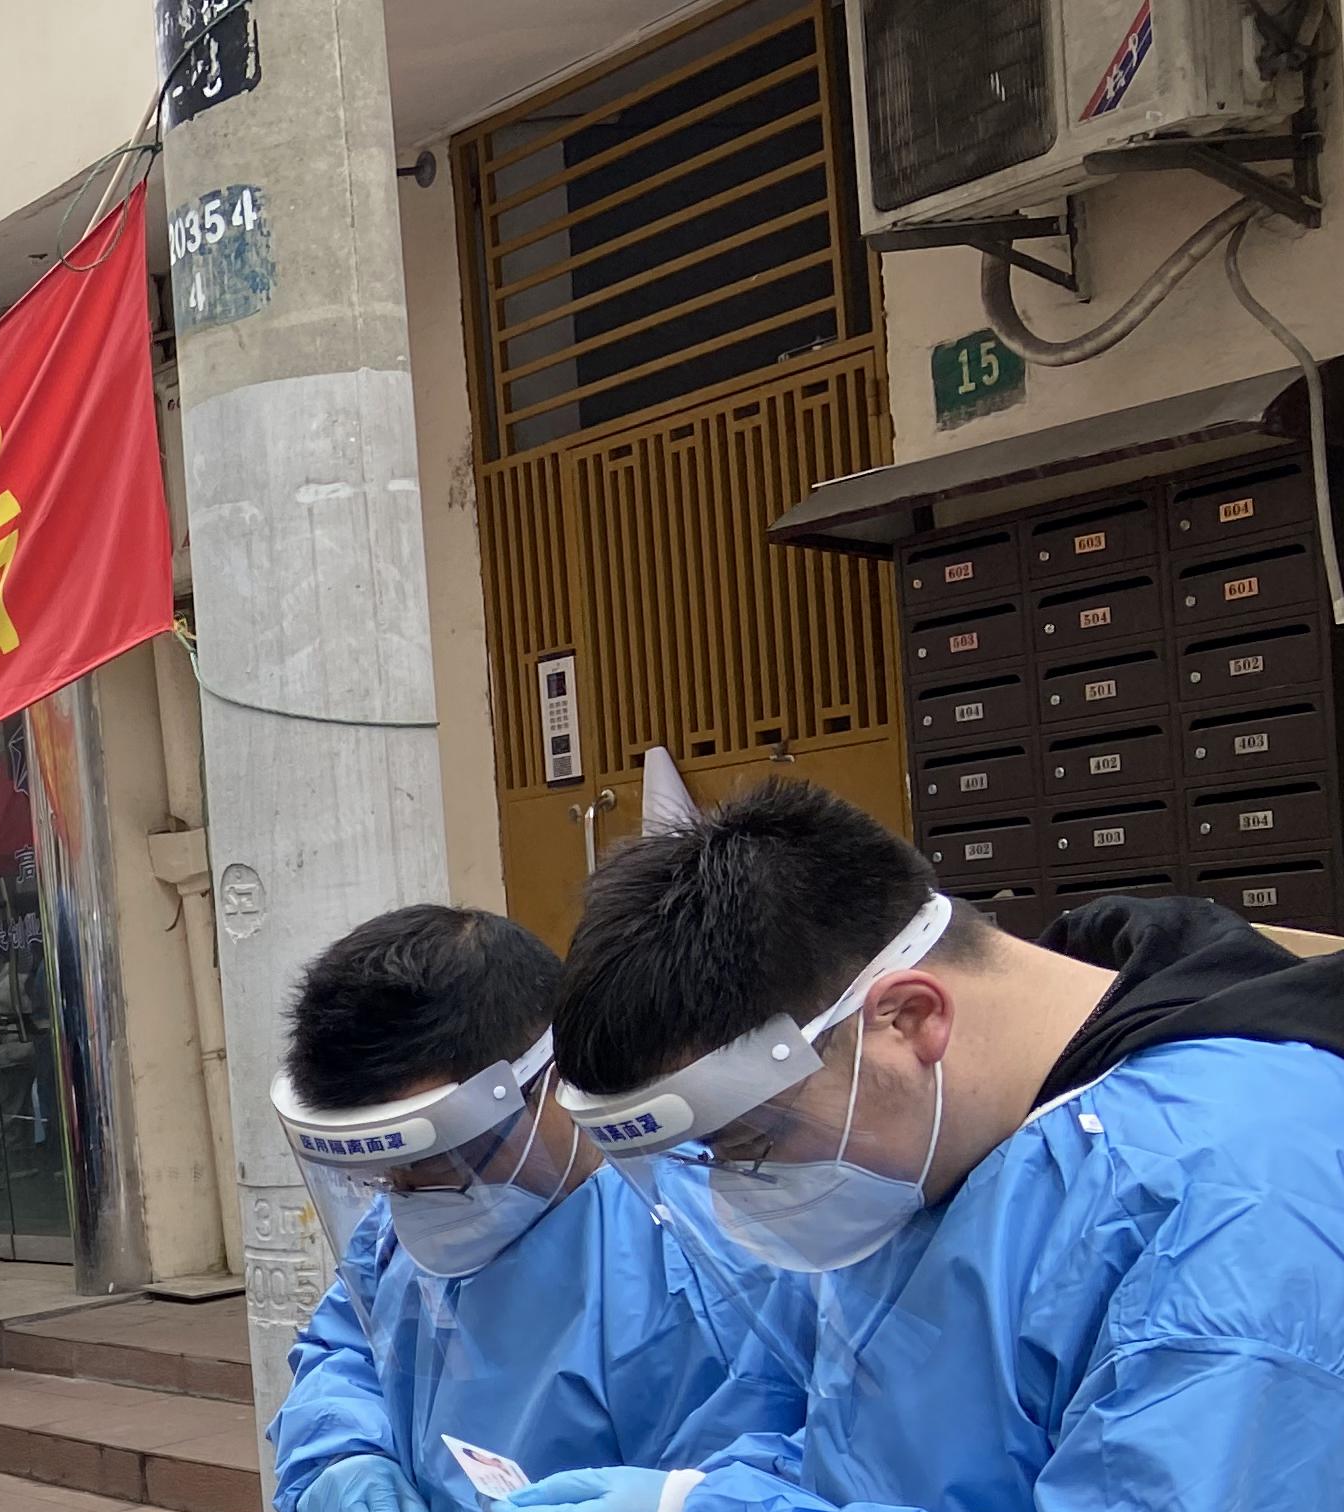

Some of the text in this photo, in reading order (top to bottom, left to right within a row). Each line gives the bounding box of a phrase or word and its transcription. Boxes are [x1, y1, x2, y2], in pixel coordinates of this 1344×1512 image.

[958, 340, 1000, 395] 15
[1223, 502, 1250, 518] 604
[1078, 536, 1103, 551] 603
[948, 566, 971, 579] 602
[1228, 581, 1255, 596] 601
[1083, 610, 1109, 625] 504
[952, 635, 975, 649] 503
[1233, 657, 1261, 672] 502
[1089, 683, 1114, 698] 501
[958, 705, 981, 719] 404
[1238, 736, 1266, 751] 403
[1093, 757, 1119, 771] 402
[964, 777, 986, 790] 401
[1242, 814, 1270, 828] 304
[1096, 831, 1122, 845] 303
[968, 844, 991, 857] 302
[1246, 890, 1274, 904] 301
